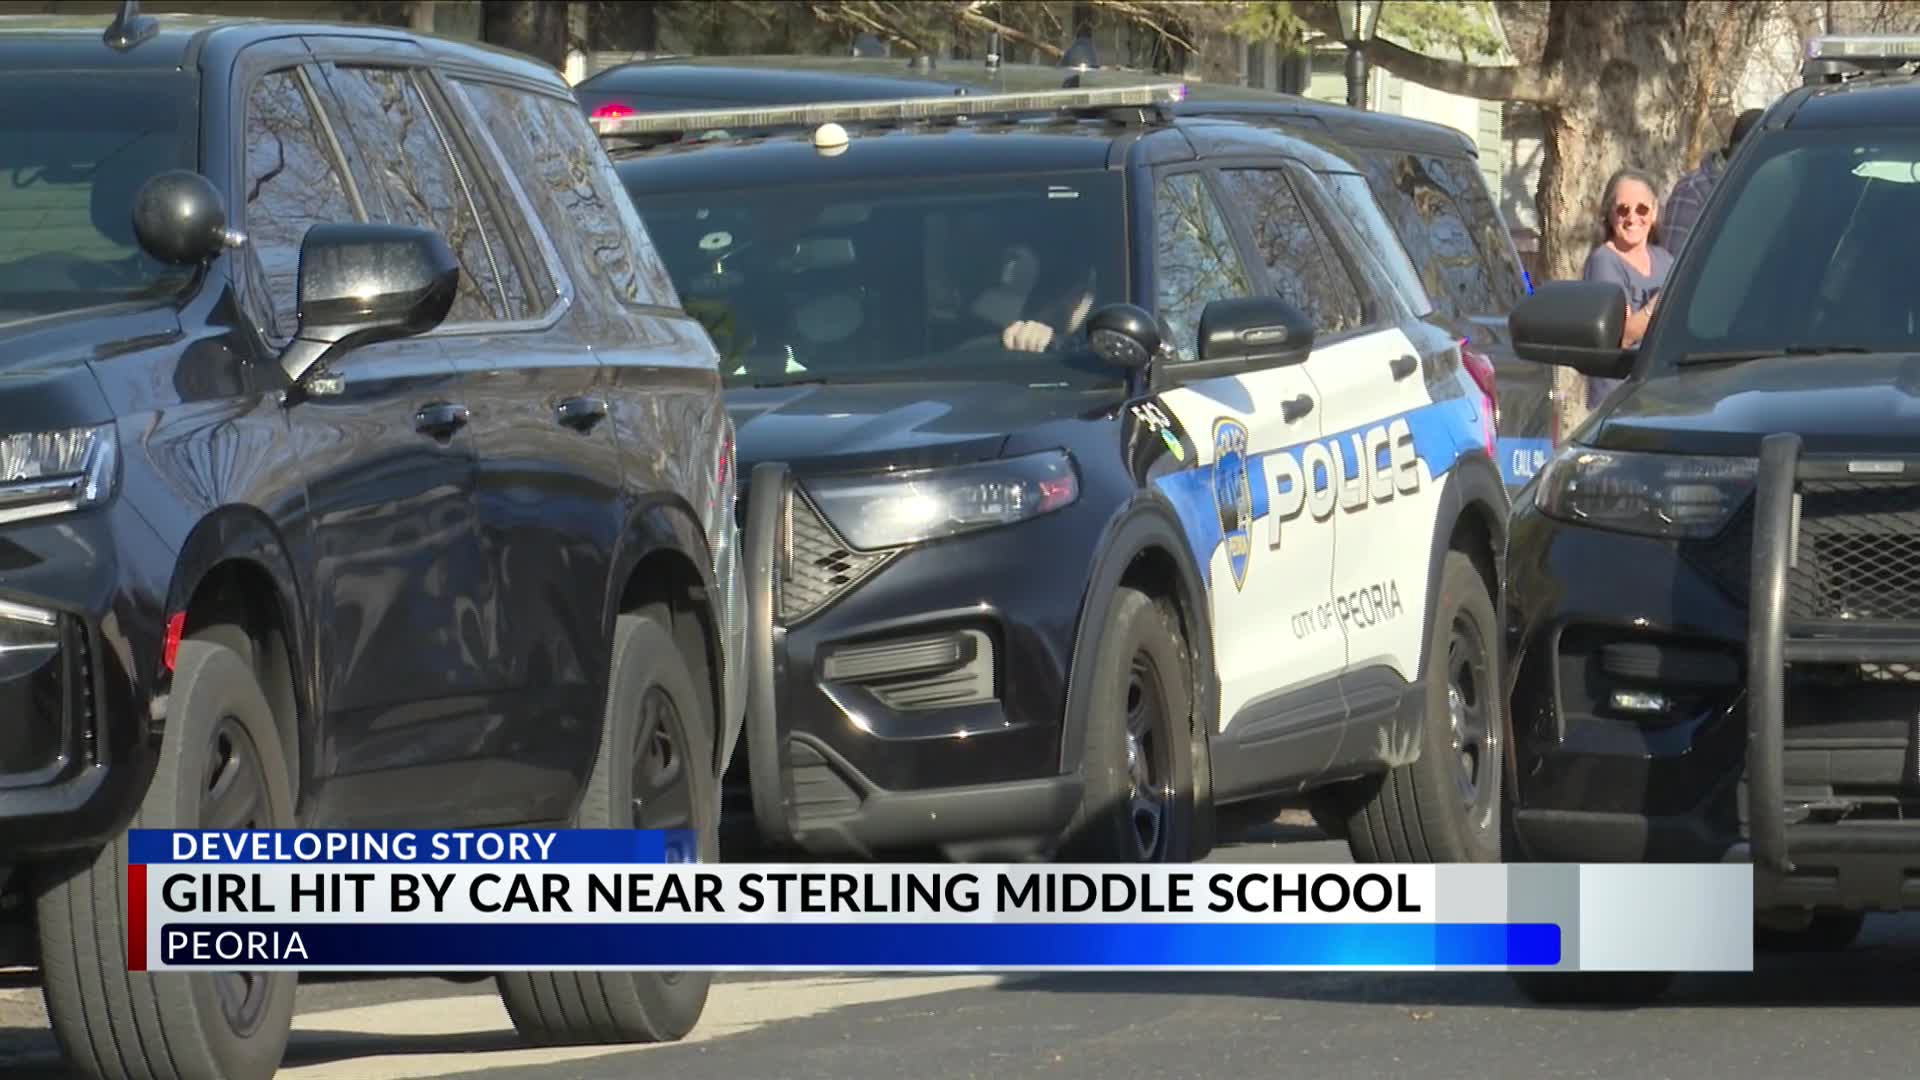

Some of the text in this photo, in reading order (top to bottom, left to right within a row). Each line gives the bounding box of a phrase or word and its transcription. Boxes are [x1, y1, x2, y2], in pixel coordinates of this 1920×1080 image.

[1263, 417, 1419, 551] POLICE
[1291, 579, 1404, 639] CITY OF PEORIA
